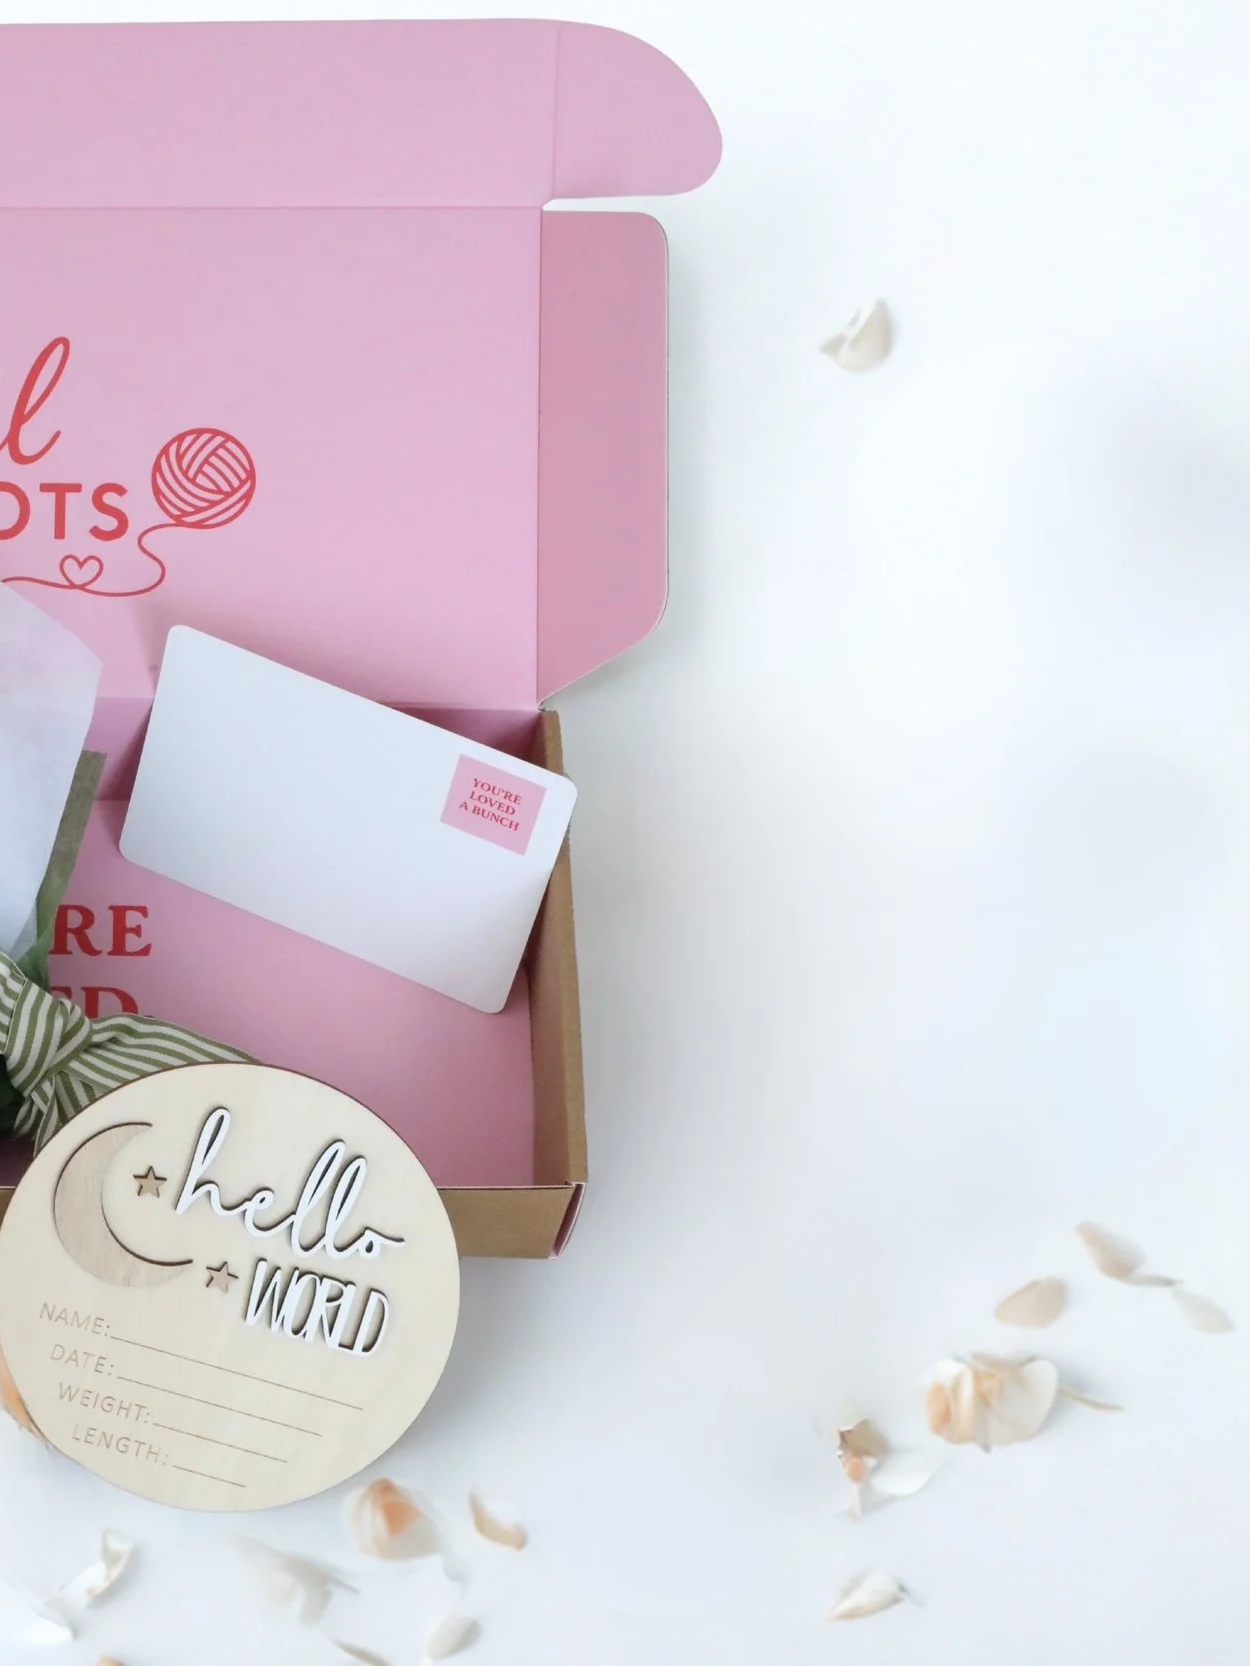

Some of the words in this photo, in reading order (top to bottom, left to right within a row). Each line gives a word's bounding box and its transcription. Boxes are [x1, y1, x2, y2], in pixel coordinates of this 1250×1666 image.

[470, 791, 516, 815] LOVED
[473, 778, 522, 805] YOU'RE
[459, 801, 468, 811] A
[472, 805, 520, 831] BUNCH
[175, 1106, 406, 1259] hello
[39, 1302, 110, 1336] NAME:
[244, 1258, 390, 1357] WORLD
[50, 1344, 114, 1376] DATE:
[59, 1382, 150, 1424] WEIGHT:
[72, 1423, 169, 1466] LENGTH:
